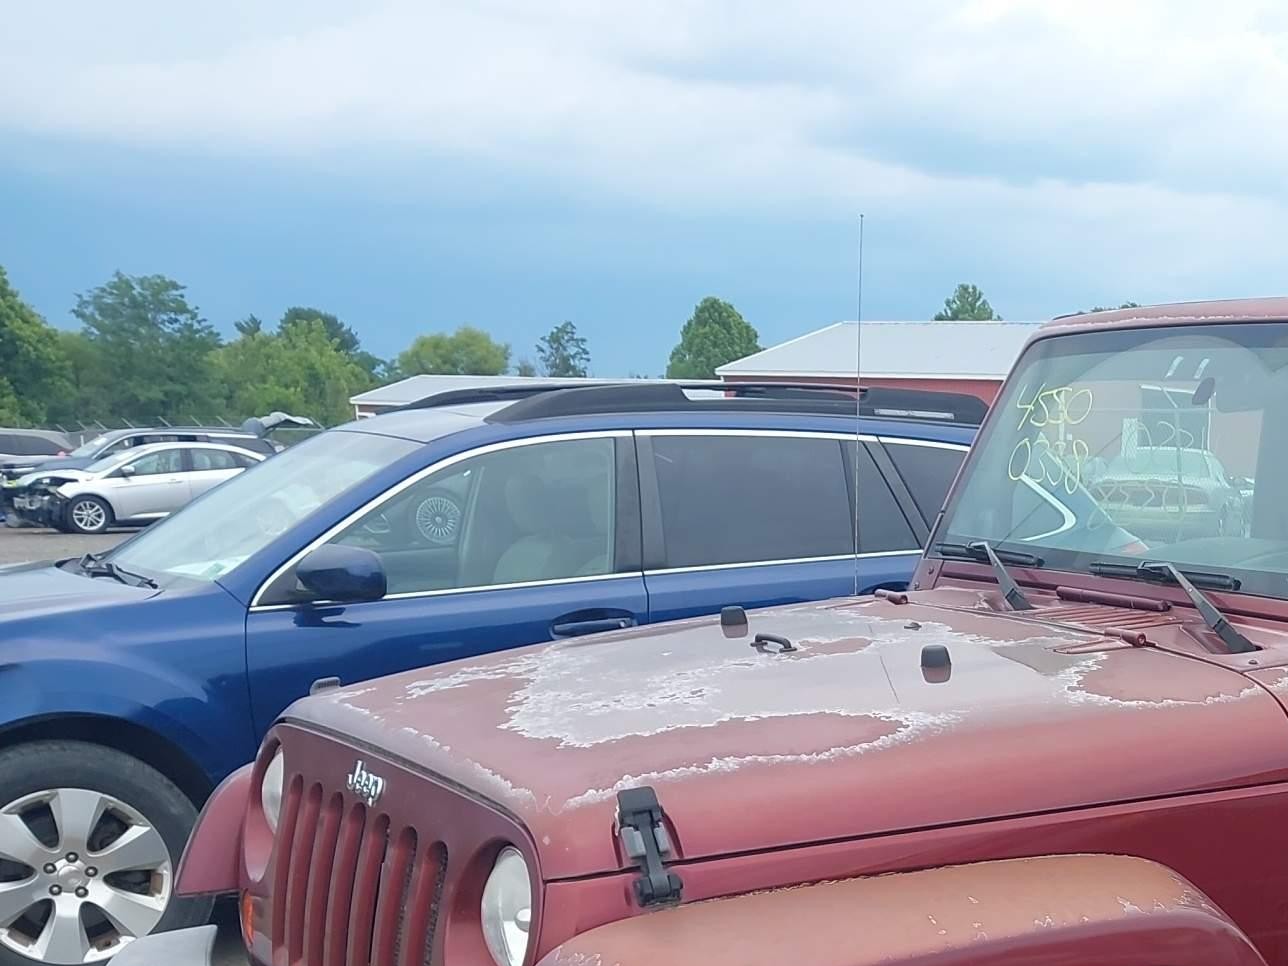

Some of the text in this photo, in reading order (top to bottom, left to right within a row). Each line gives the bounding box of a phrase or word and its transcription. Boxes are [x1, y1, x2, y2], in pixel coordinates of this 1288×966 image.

[1016, 383, 1094, 431] 4550
[1008, 437, 1089, 494] 0338
[347, 759, 386, 808] Jeep
